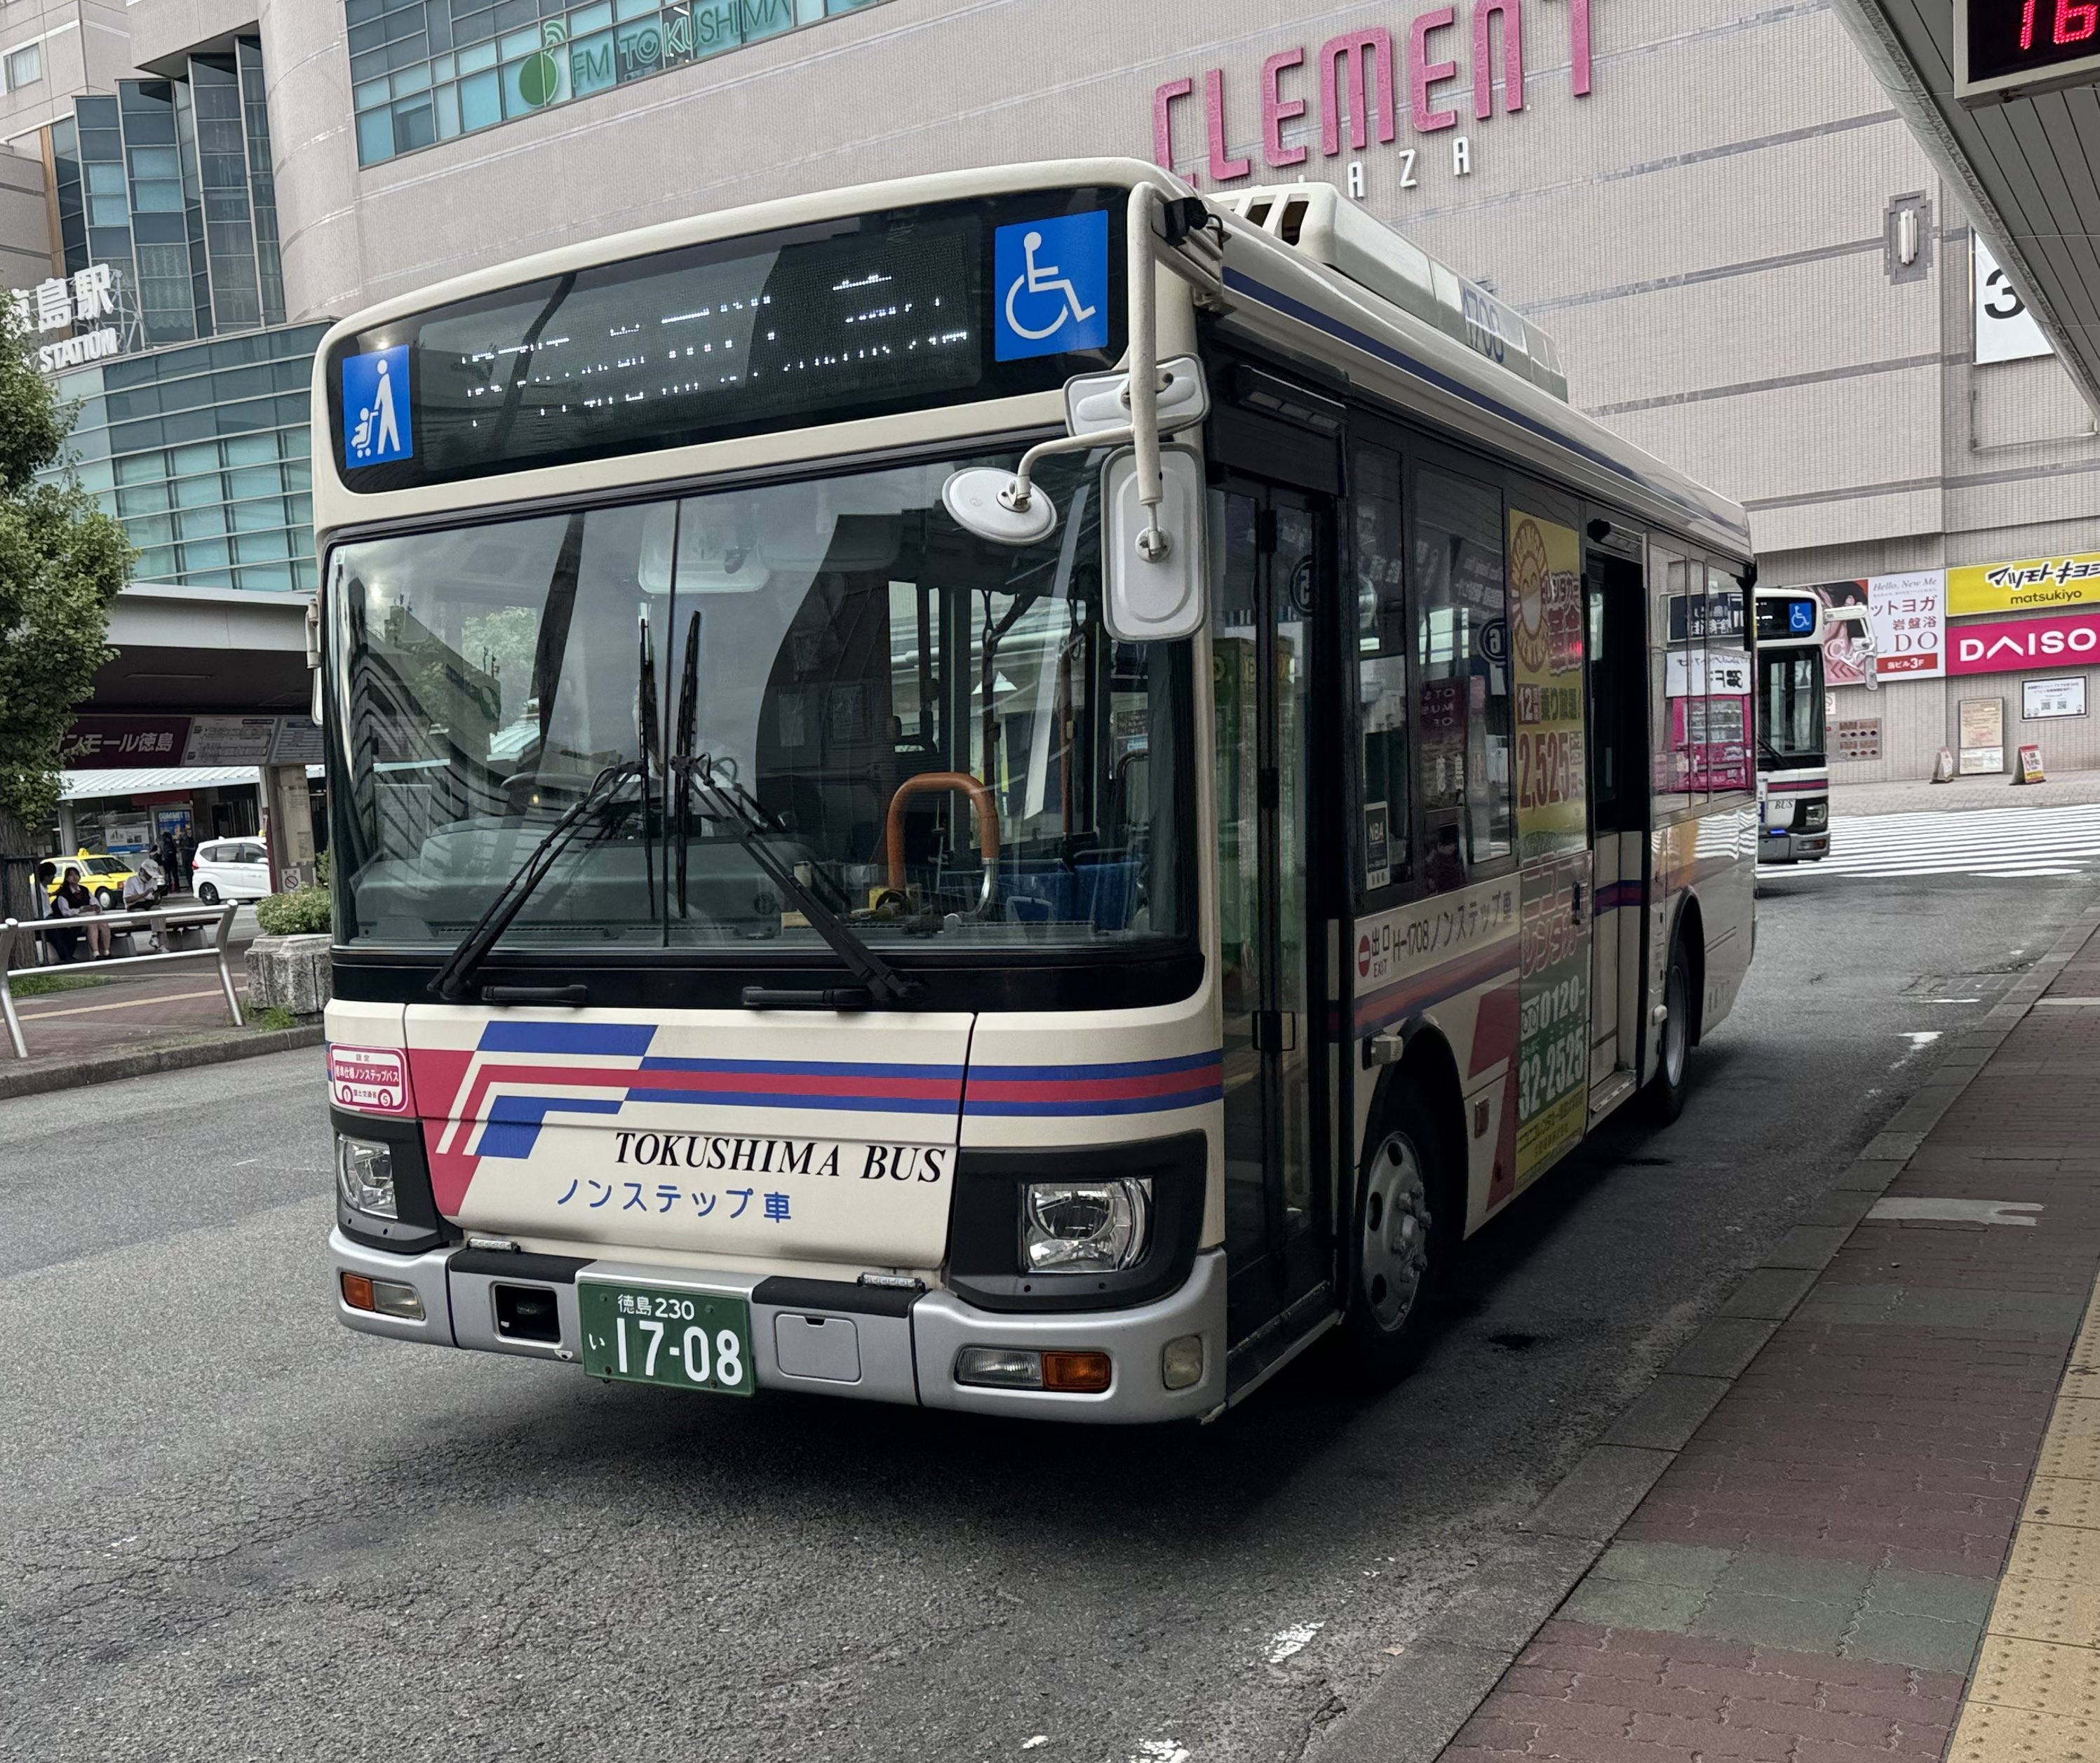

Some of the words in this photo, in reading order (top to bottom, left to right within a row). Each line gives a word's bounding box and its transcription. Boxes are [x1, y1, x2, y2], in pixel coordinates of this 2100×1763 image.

[570, 43, 610, 85] FM
[39, 328, 119, 373] STATION
[2010, 589, 2082, 604] matsukiyo
[1892, 616, 1937, 631] 岩盤浴
[1960, 628, 2097, 662] DAISO
[1775, 800, 1793, 809] BUS
[1371, 925, 1389, 957] 出口
[1373, 958, 1388, 978] EXIT
[1518, 1025, 1584, 1120] 32-2525
[616, 1132, 840, 1177] TOKUSHIMA
[859, 1144, 947, 1183] BUS
[557, 1179, 792, 1224] ノンステップ車
[588, 1333, 605, 1350] い
[616, 1317, 743, 1386] 17-08
